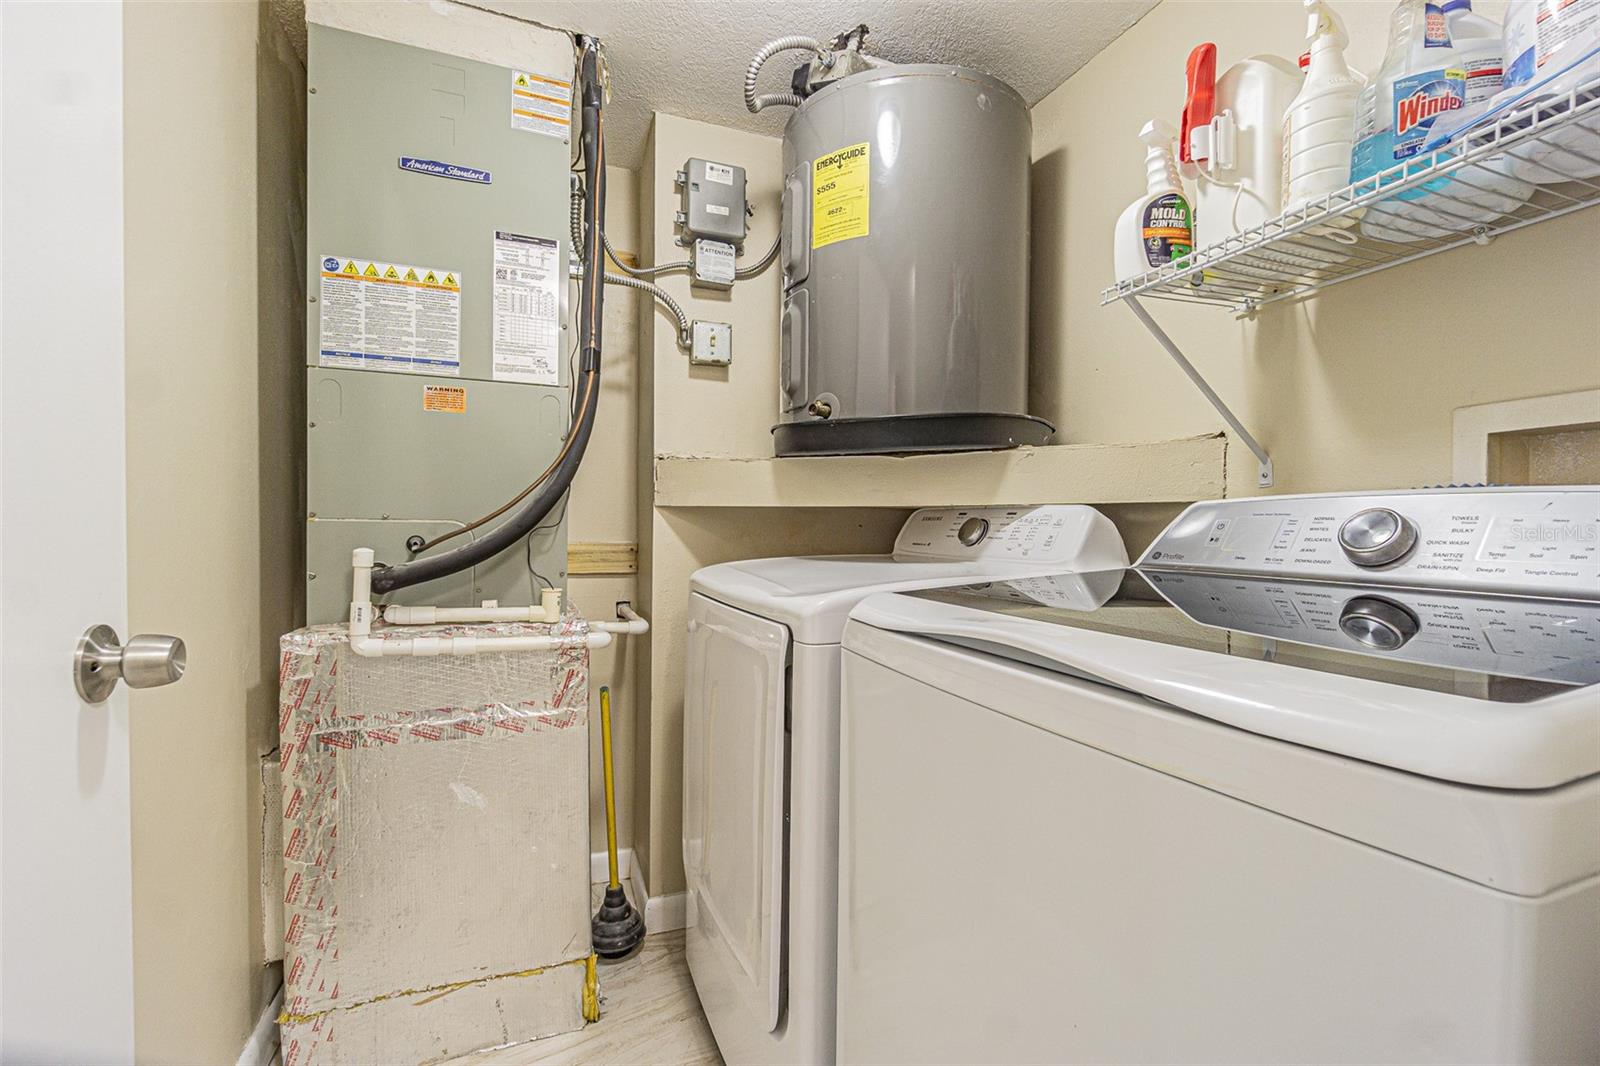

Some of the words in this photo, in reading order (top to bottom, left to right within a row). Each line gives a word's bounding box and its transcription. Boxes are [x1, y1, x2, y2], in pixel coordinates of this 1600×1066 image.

[1398, 91, 1464, 135] Windex
[816, 147, 866, 171] ENERGYGUIDE
[406, 159, 445, 174] American
[445, 166, 486, 180] Standard
[816, 182, 836, 195] $555
[1150, 207, 1186, 220] MOLD
[1150, 219, 1187, 228] CONTROL
[705, 247, 733, 257] ATTENTION
